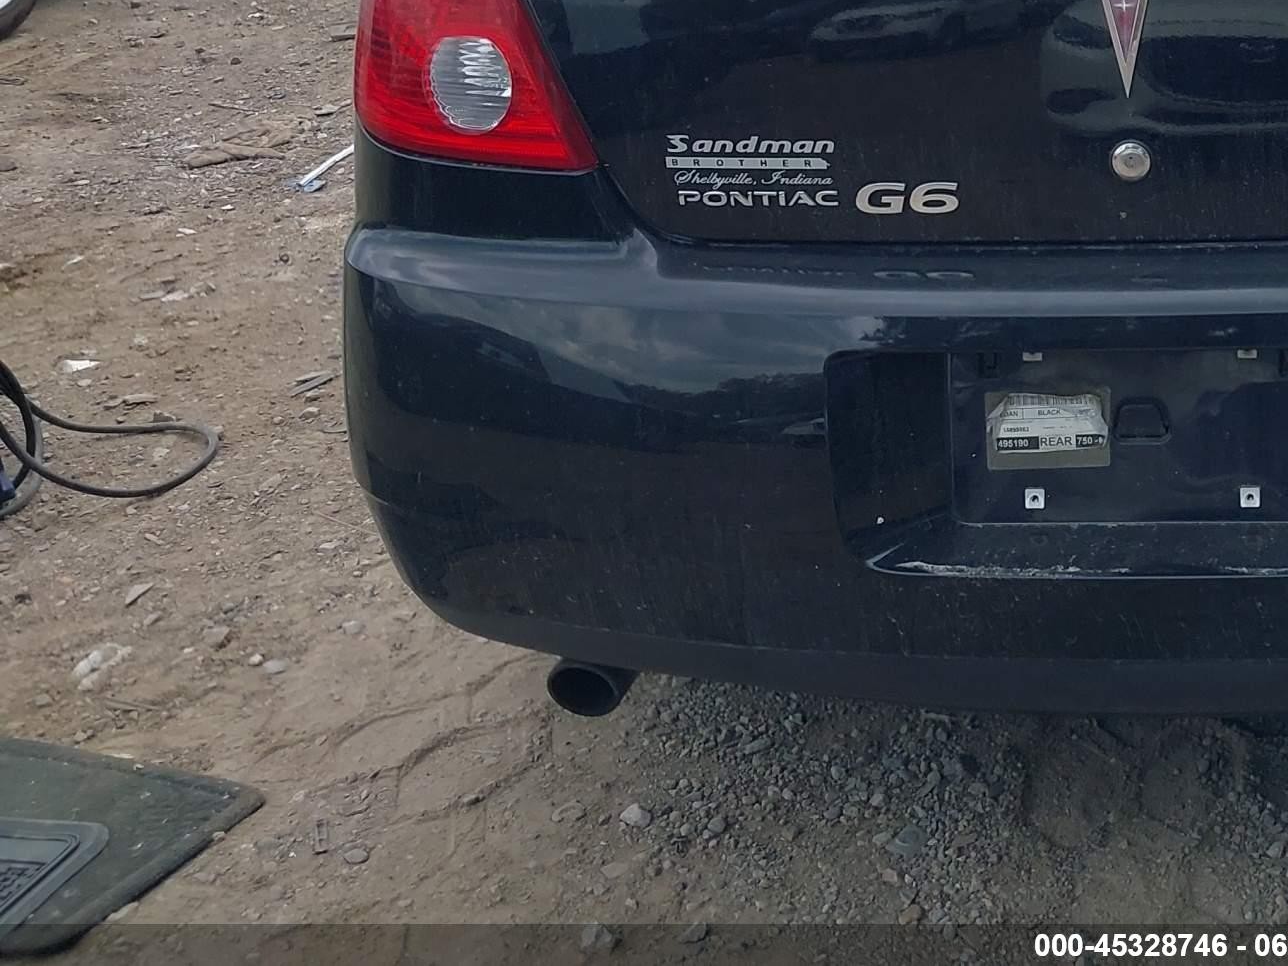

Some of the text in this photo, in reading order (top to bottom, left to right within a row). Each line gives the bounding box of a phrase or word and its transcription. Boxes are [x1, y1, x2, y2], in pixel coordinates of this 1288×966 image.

[666, 135, 835, 154] Sandman
[674, 170, 833, 190] Shelbyville, Indiana
[677, 190, 839, 207] PONTIAC
[855, 181, 960, 214] G6
[1038, 408, 1061, 416] BLACK
[1040, 436, 1073, 447] REAR
